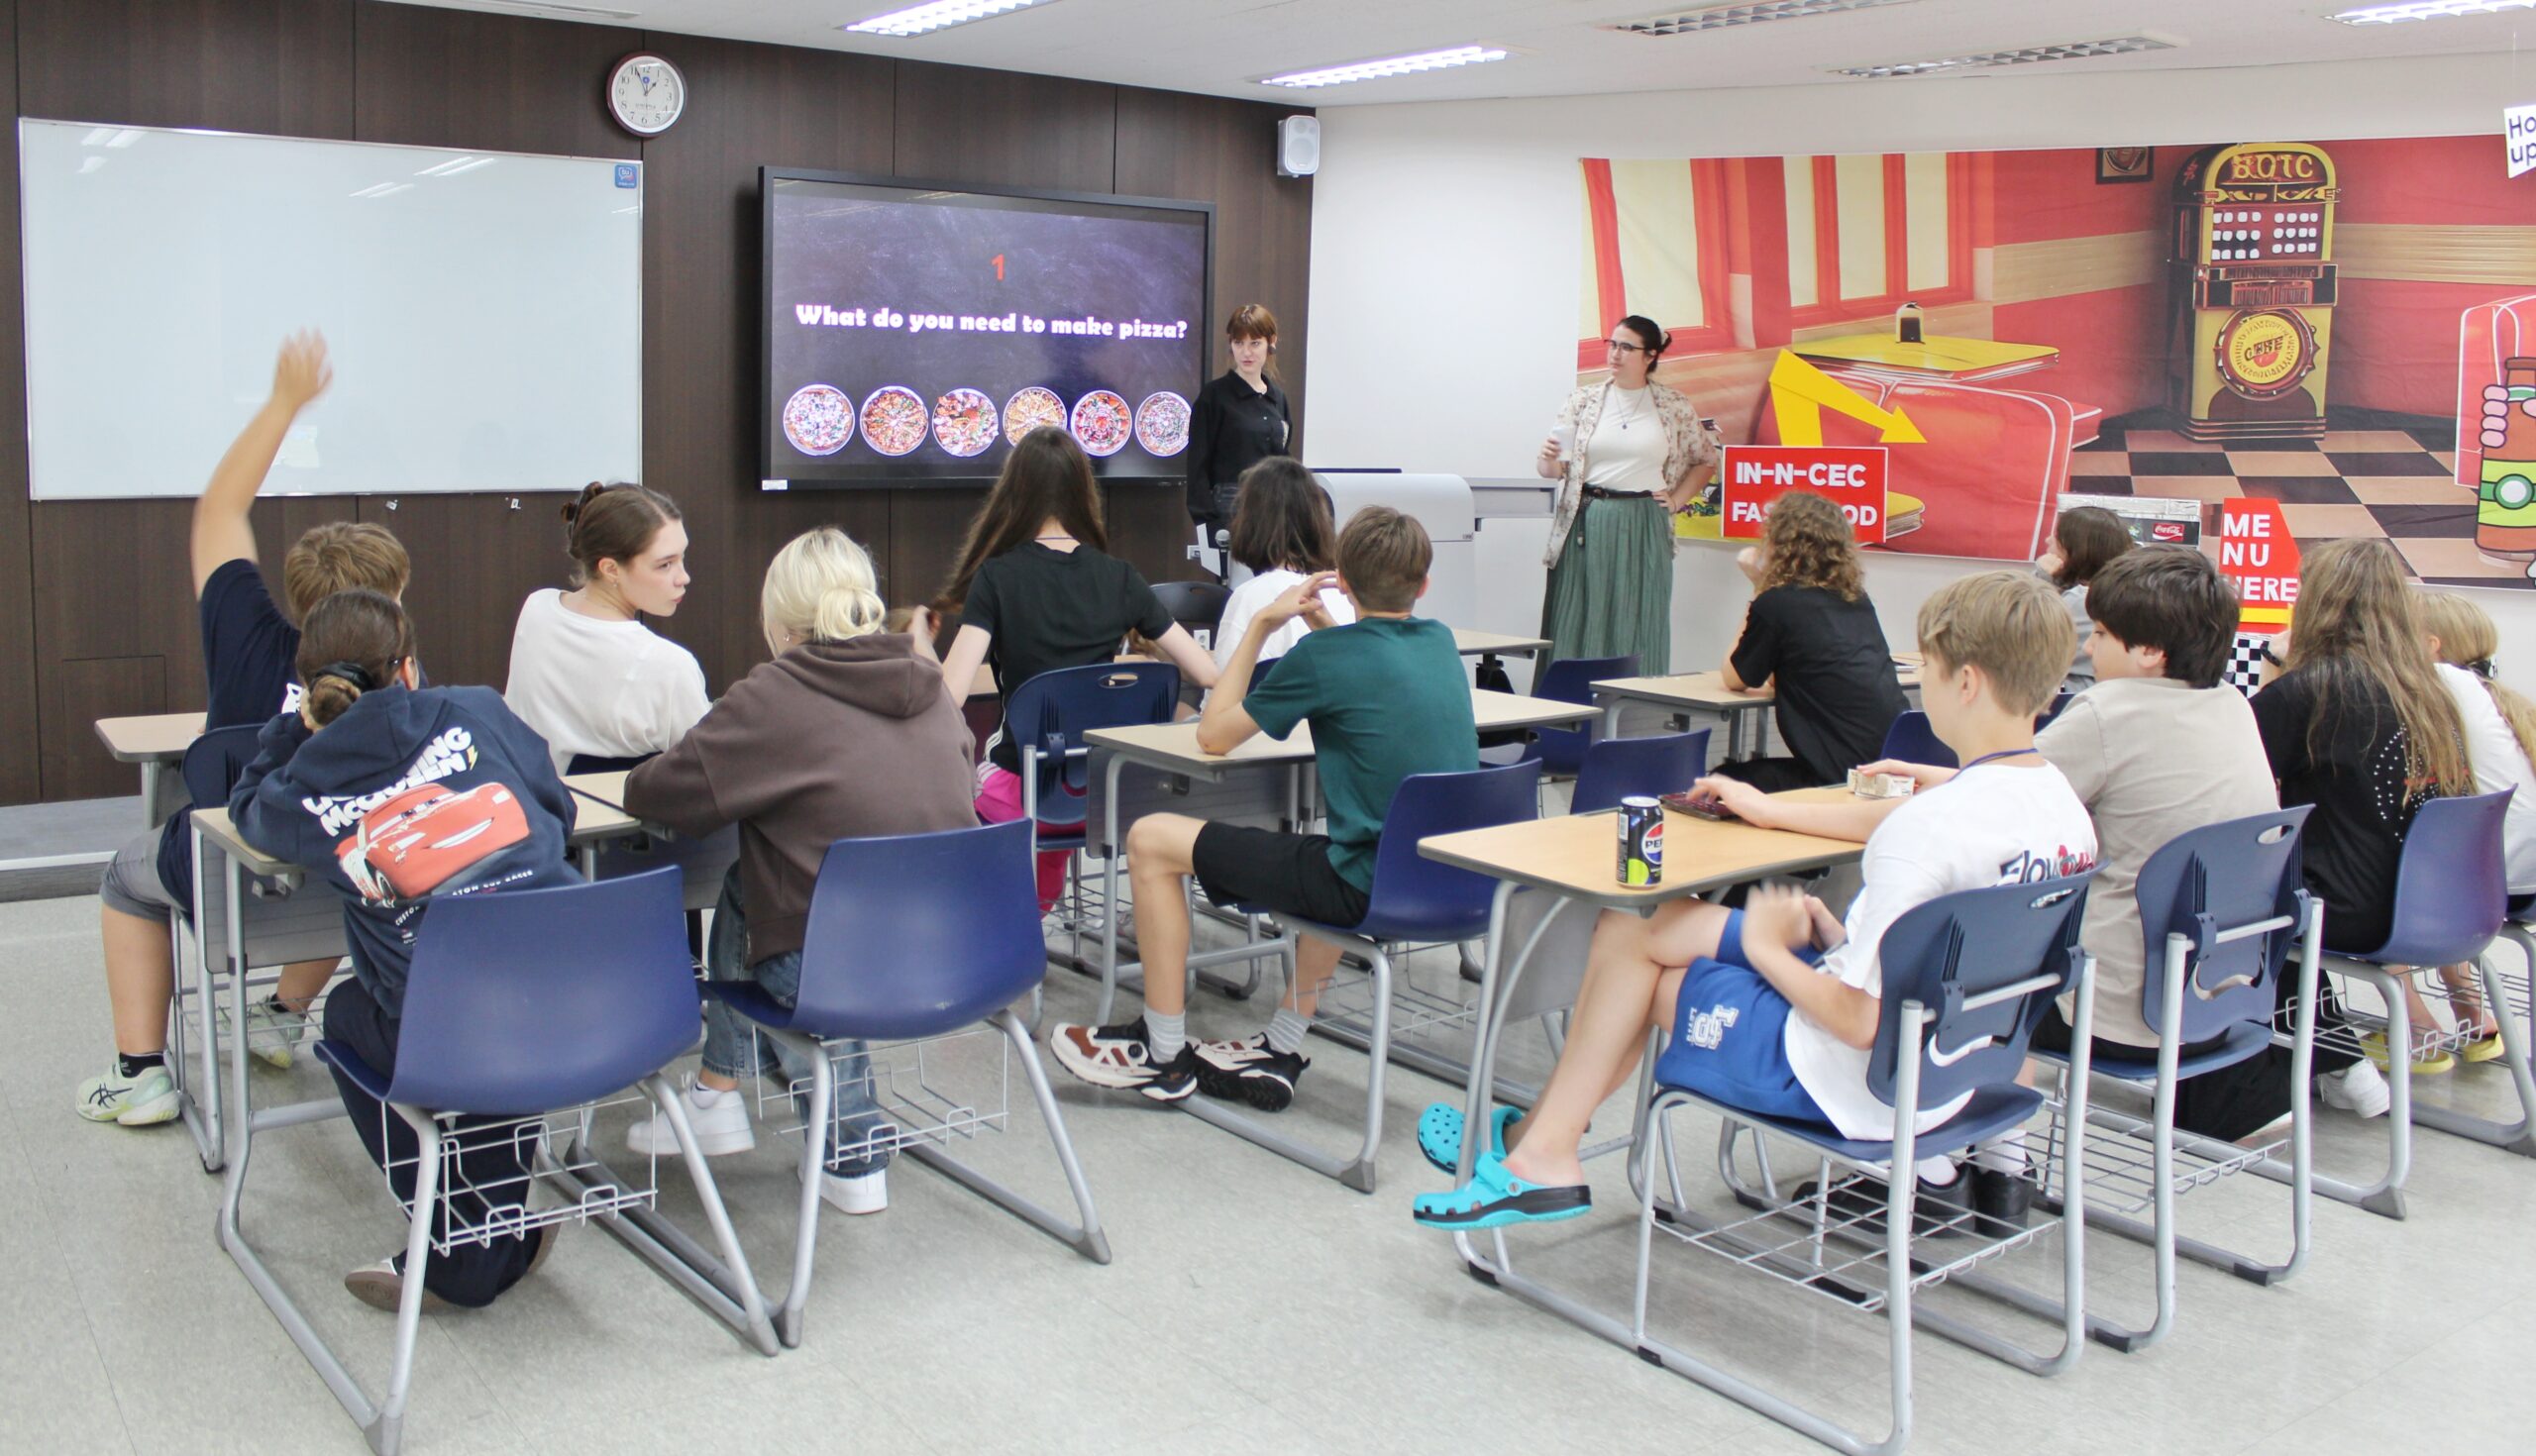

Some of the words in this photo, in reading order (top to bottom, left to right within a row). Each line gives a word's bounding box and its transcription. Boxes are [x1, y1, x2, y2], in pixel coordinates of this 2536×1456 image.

[991, 254, 1004, 281] 1
[795, 304, 867, 327] What
[872, 307, 904, 328] do
[908, 313, 954, 333] you
[960, 313, 1016, 332] need
[1022, 314, 1046, 334] to
[1051, 316, 1114, 336] make
[1118, 318, 1188, 340] pizza?
[1736, 462, 1866, 487] IN-N-CEC
[2223, 513, 2272, 538] ME
